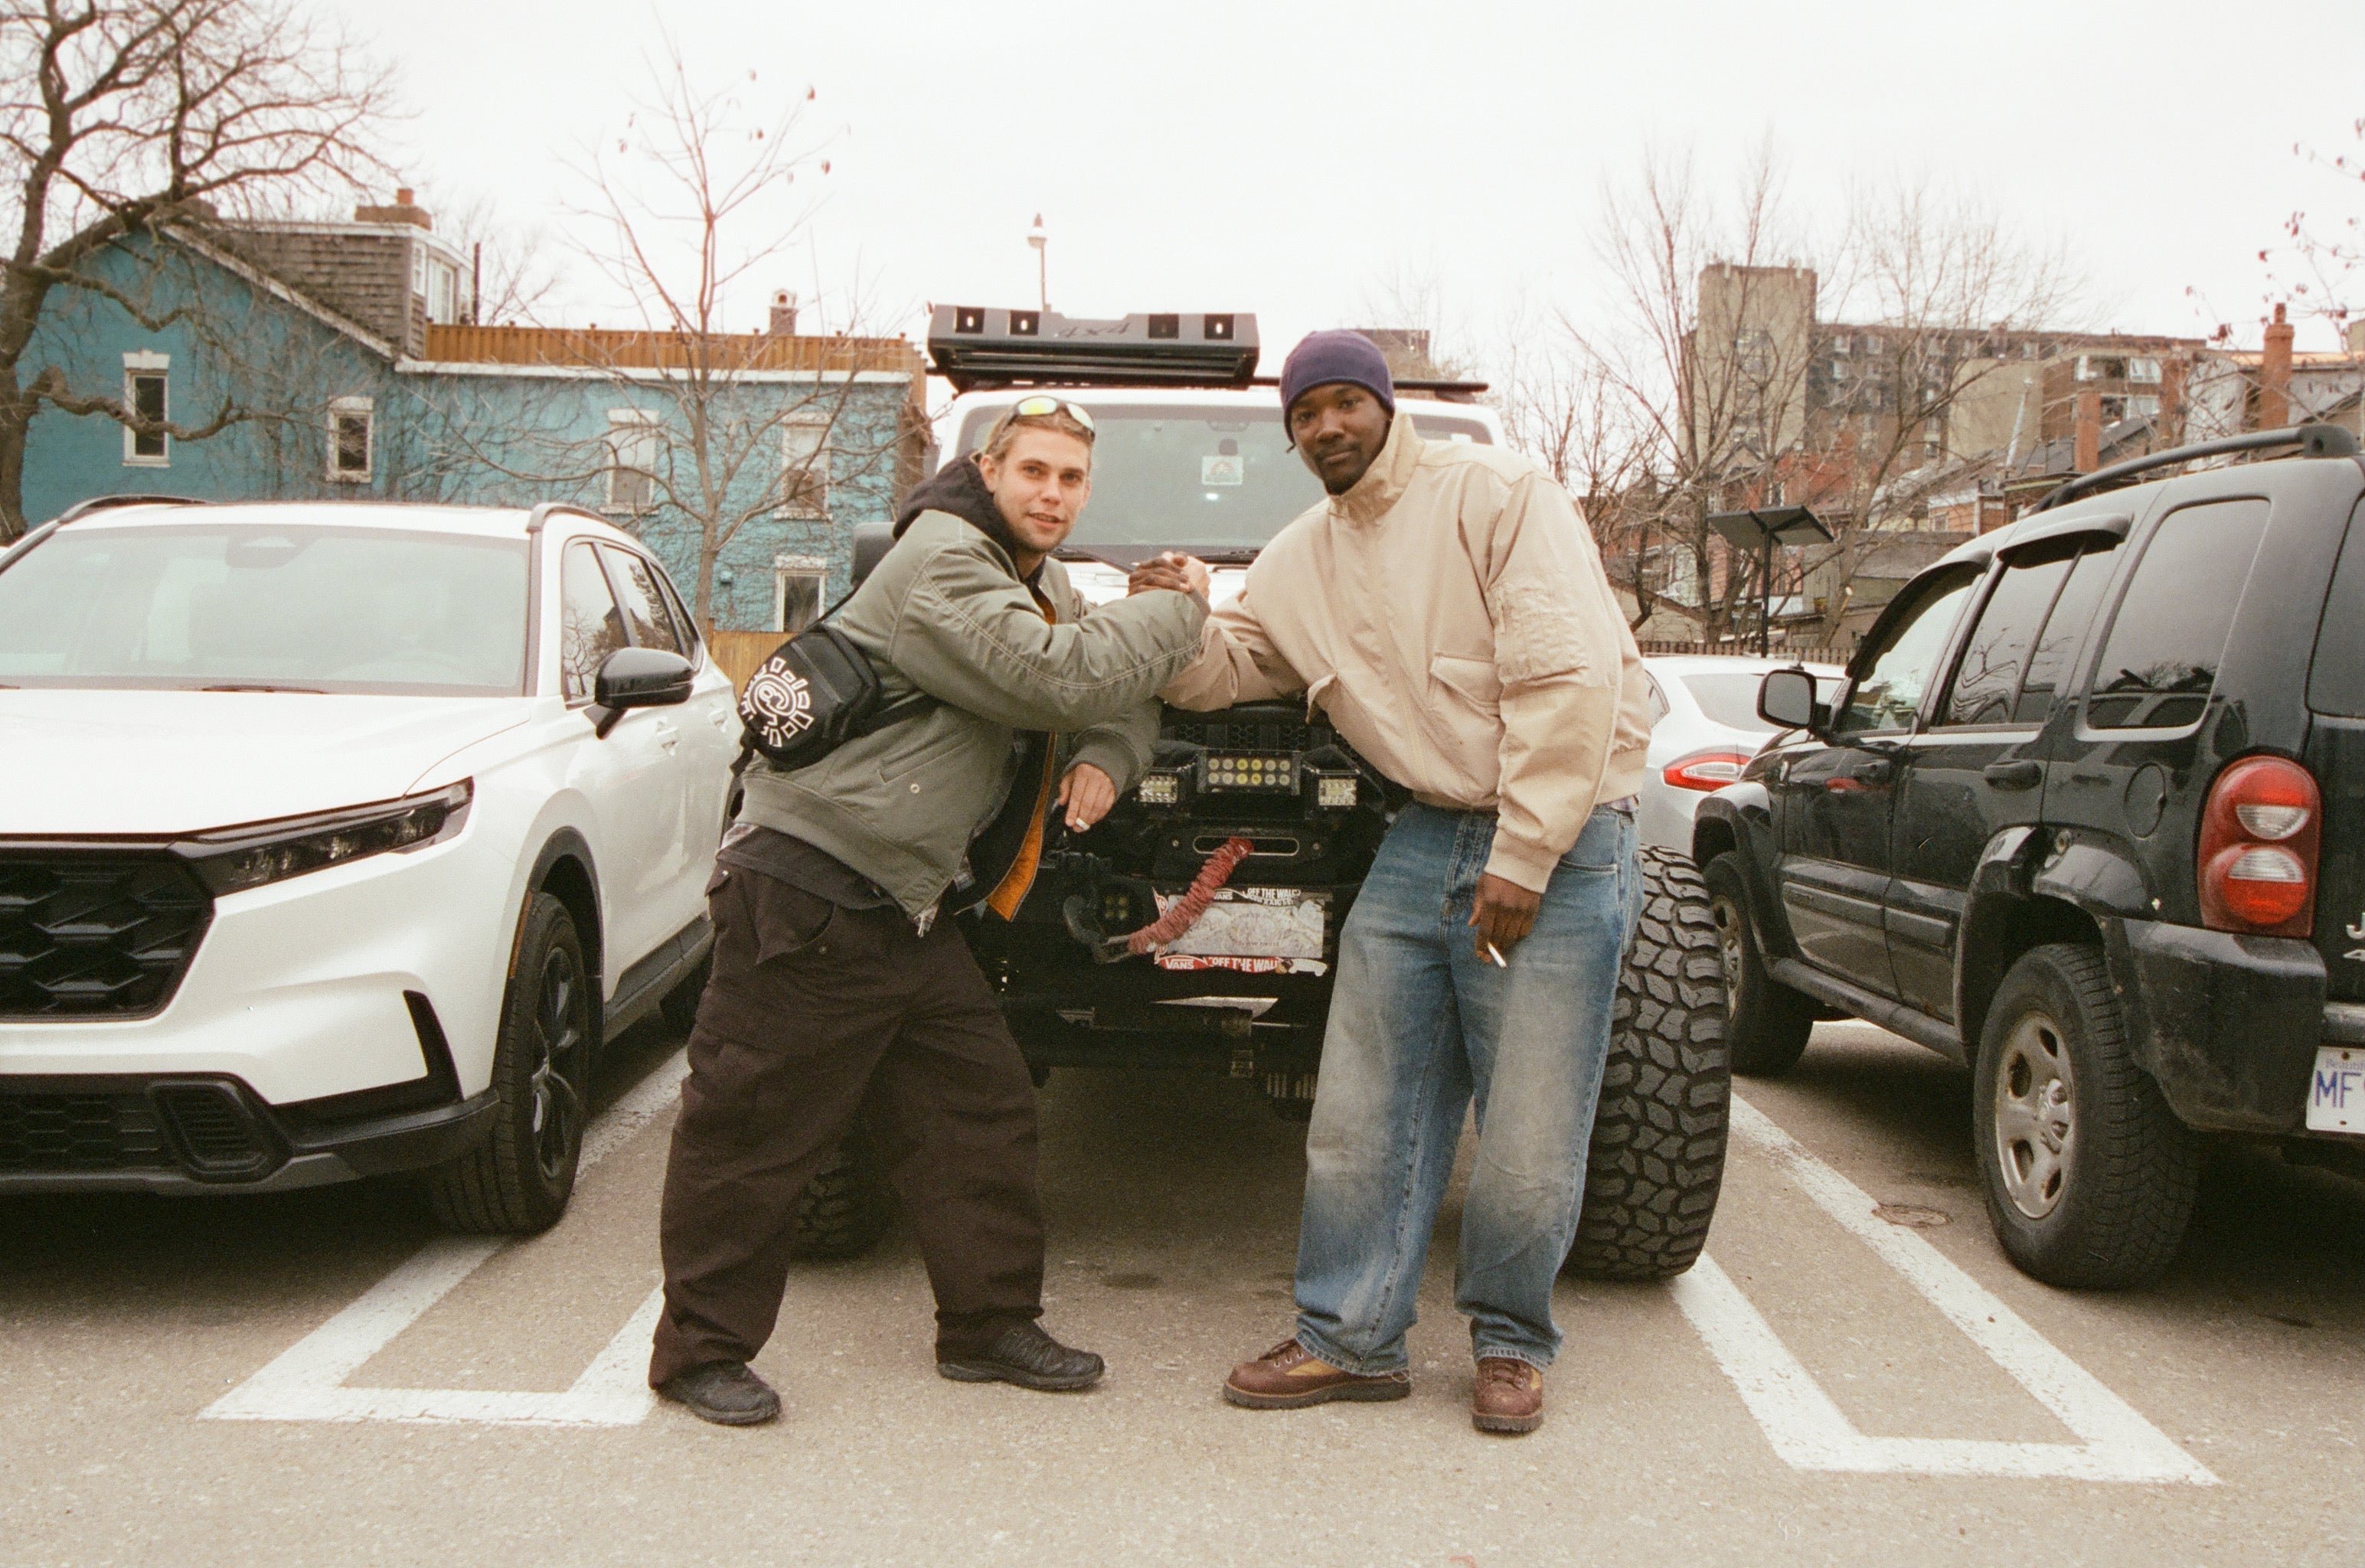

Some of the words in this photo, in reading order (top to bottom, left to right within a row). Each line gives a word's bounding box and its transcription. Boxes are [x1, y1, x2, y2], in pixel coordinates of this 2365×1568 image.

[1261, 888, 1276, 899] THE
[1165, 958, 1194, 970] VANS
[1231, 958, 1253, 972] THE
[2315, 1070, 2365, 1109] MF
